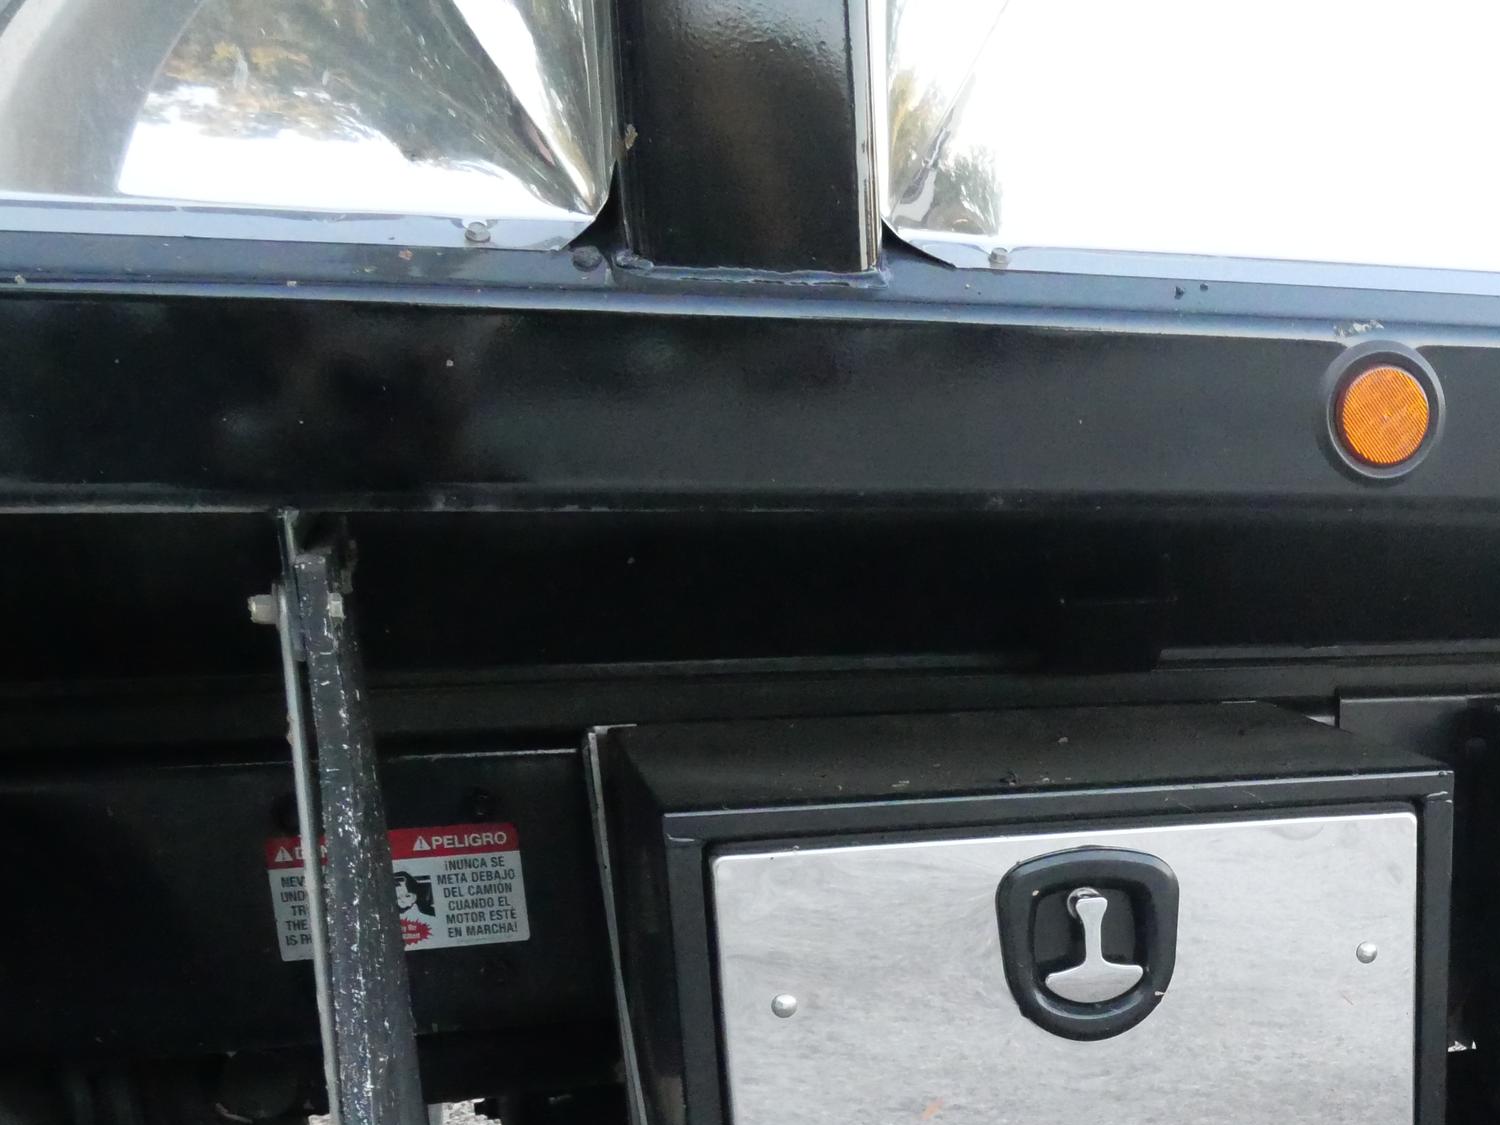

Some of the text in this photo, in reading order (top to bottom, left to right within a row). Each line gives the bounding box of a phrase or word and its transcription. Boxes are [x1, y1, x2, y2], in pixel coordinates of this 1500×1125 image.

[432, 832, 507, 849] PELIGRO
[445, 856, 505, 871] ¡NUNCA SE
[281, 876, 305, 888] NEV
[437, 869, 516, 885] META DEBAJO
[443, 887, 464, 898] DEL
[448, 896, 511, 911] CUANDO EL
[446, 911, 486, 924] MOTOR
[286, 920, 308, 931] THE
[448, 922, 518, 938] EN MARCHA!
[286, 935, 298, 946] IS
